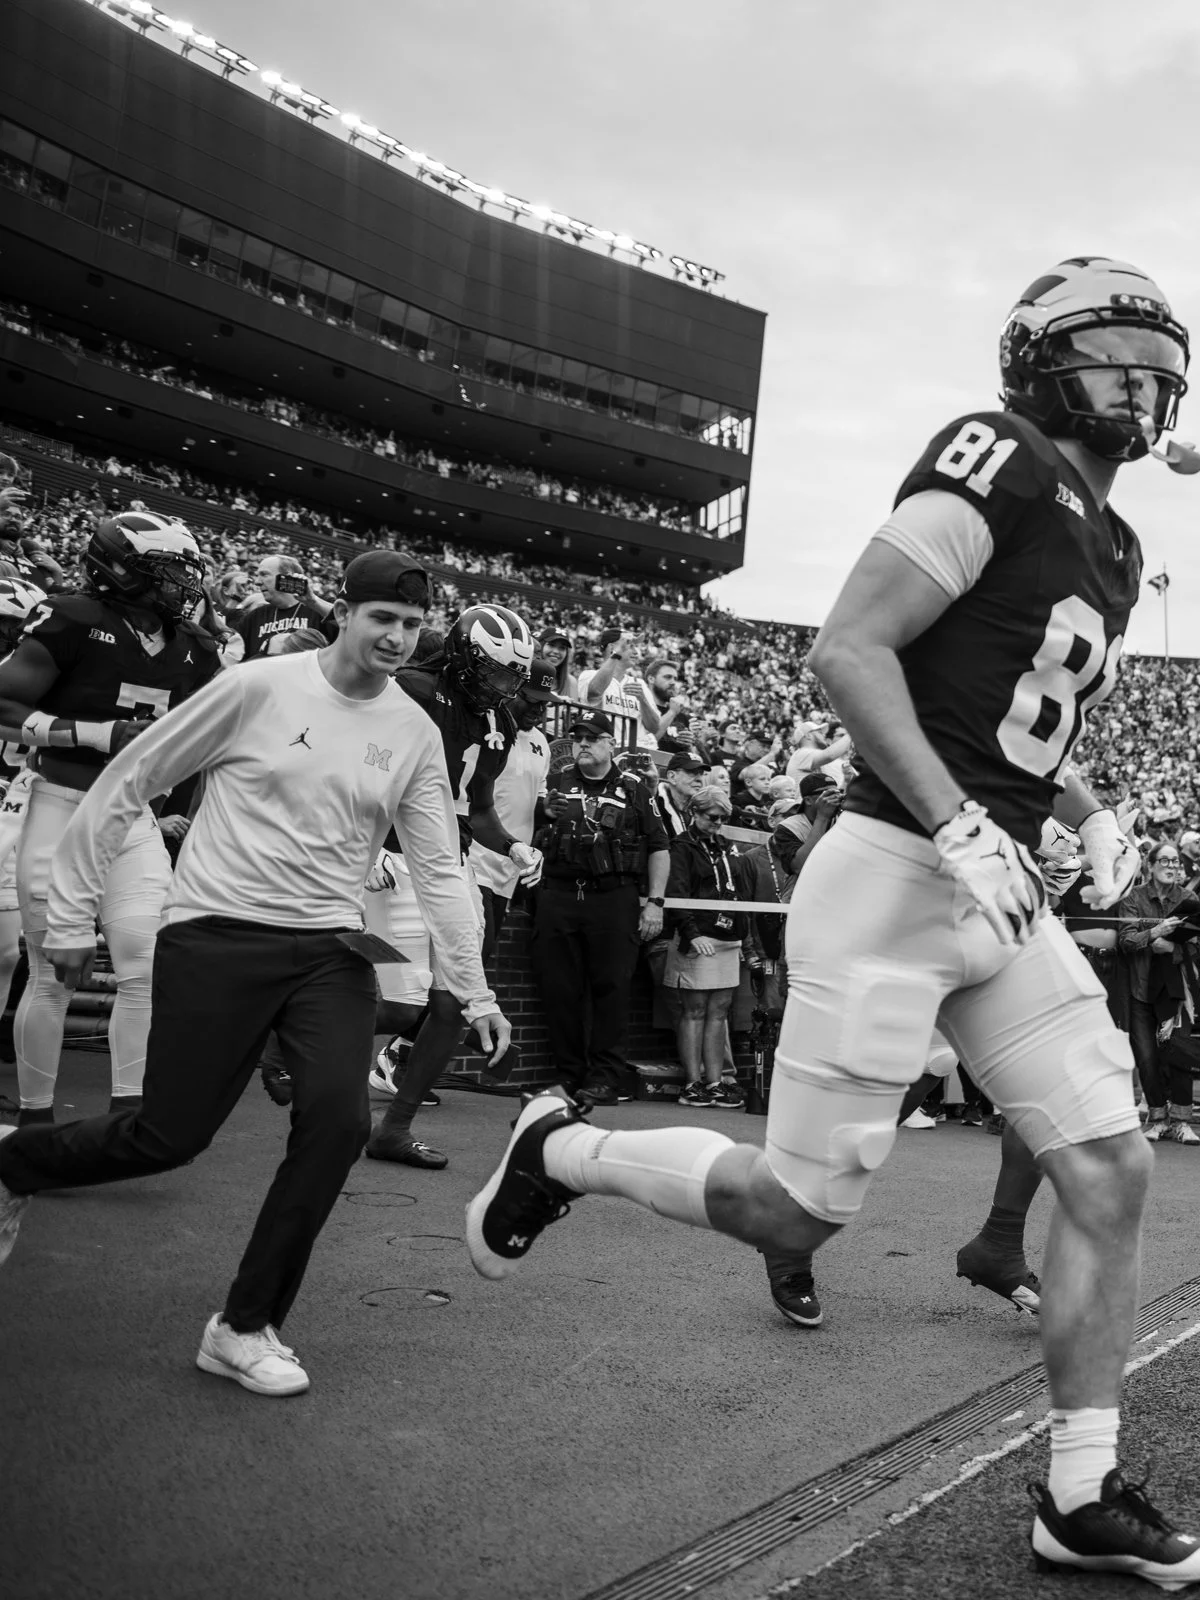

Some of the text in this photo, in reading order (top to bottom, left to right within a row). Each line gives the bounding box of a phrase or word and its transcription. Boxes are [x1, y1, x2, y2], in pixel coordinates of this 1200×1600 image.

[935, 420, 1019, 498] 81
[24, 604, 53, 634] 7
[258, 617, 308, 638] MICHIGAN
[364, 743, 392, 772] M
[530, 742, 544, 757] M
[453, 743, 481, 816] 1
[2, 801, 23, 813] M
[507, 1234, 529, 1248] M
